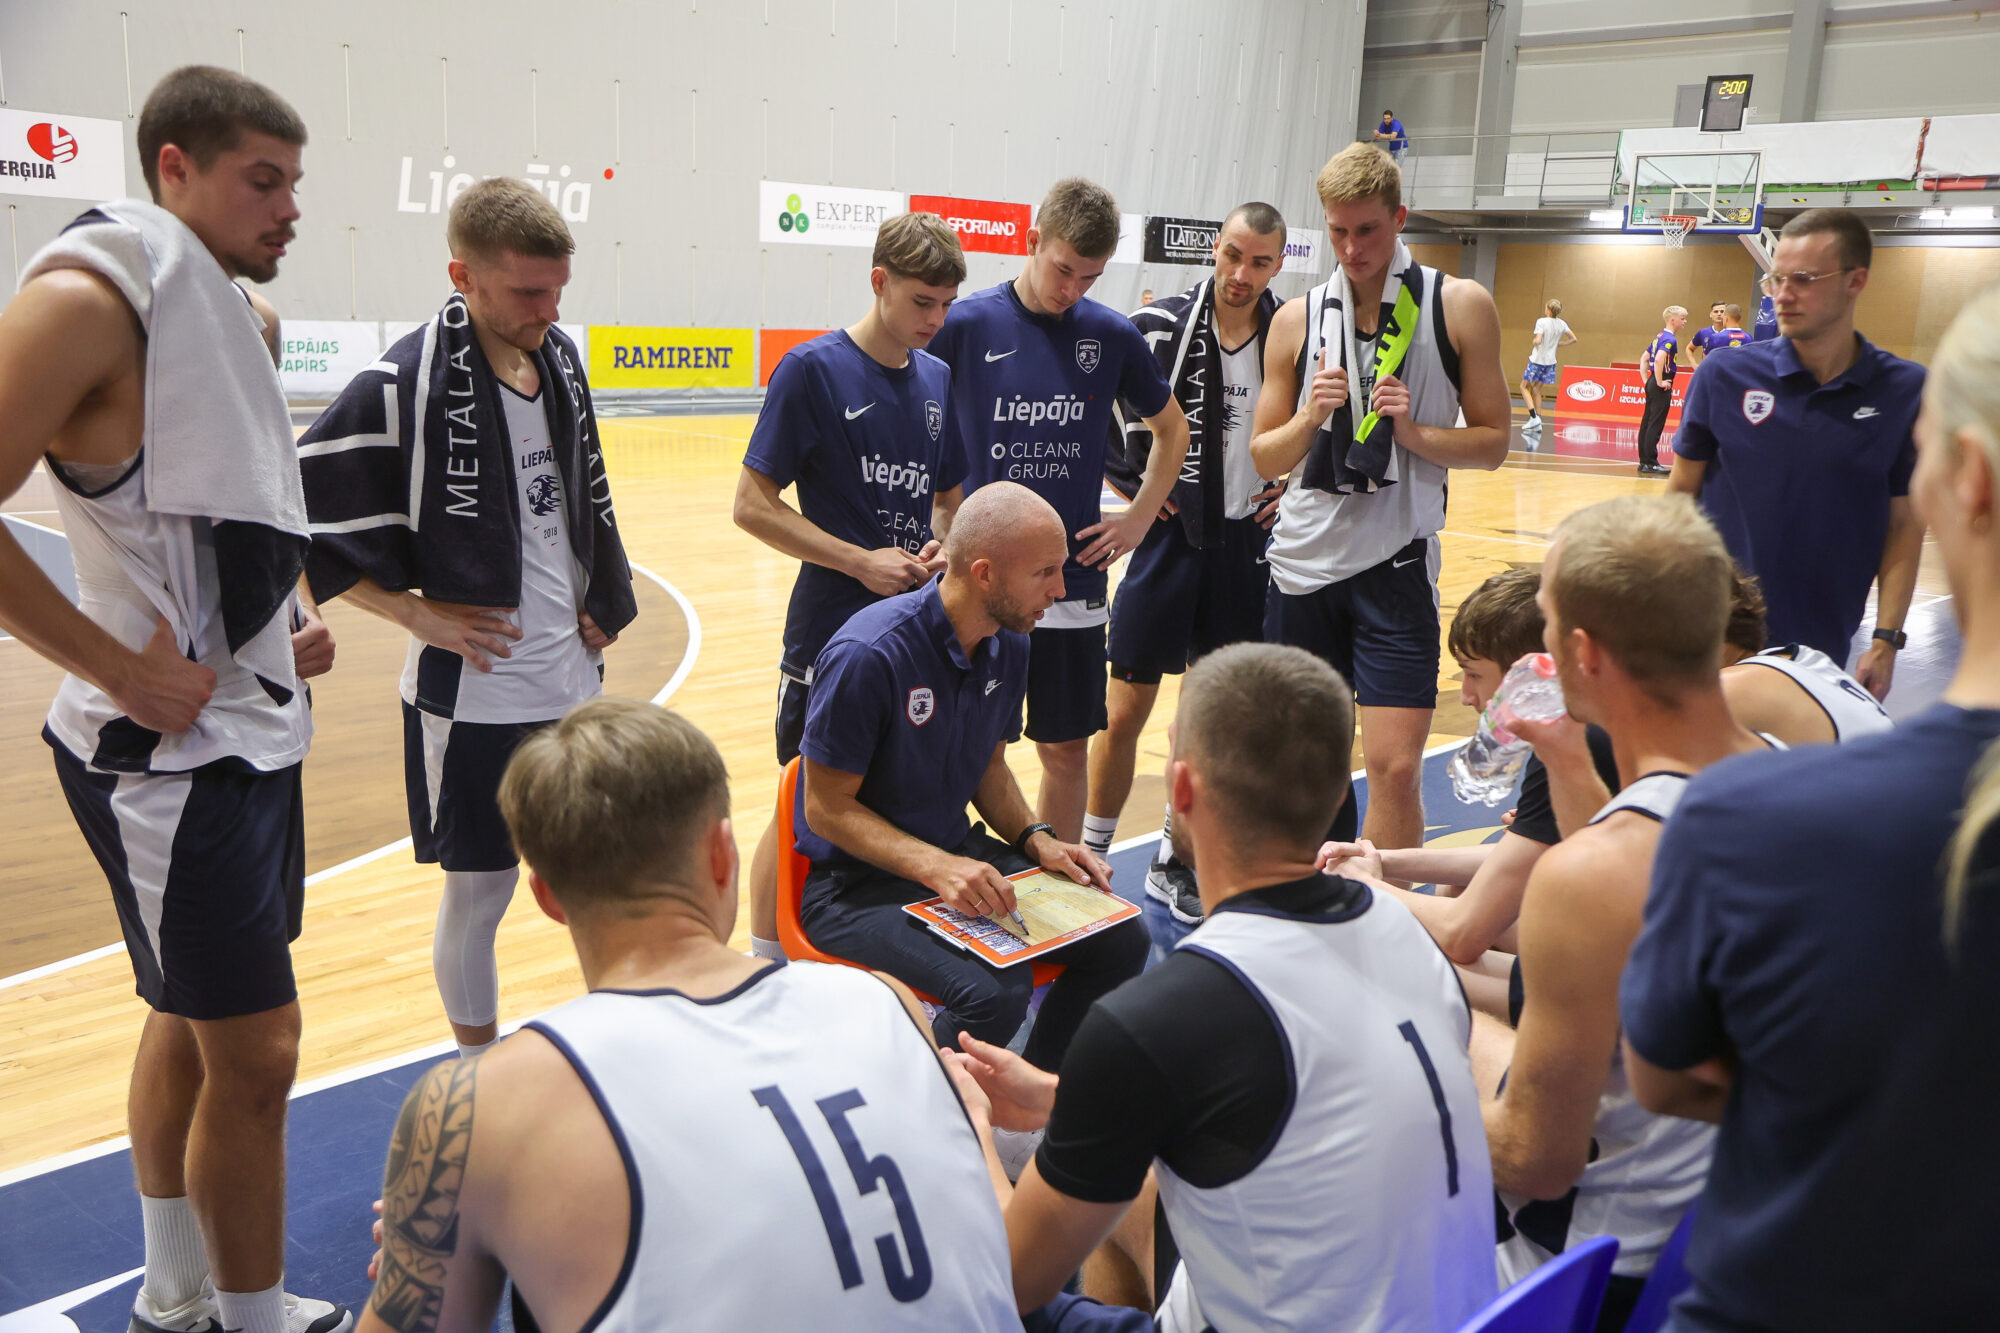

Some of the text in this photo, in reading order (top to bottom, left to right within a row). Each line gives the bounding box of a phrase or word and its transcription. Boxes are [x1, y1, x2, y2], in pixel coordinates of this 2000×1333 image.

[1719, 80, 1747, 95] 2:00
[0, 160, 56, 182] ERĢIJA
[816, 202, 887, 223] EXPERT
[947, 217, 1016, 236] SPORTLAND
[1286, 243, 1311, 258] ABALT
[281, 337, 339, 354] IEPĀJAS
[613, 346, 733, 369] RAMIRENT
[993, 394, 1085, 427] Liepāja
[445, 344, 478, 518] METĀLA
[522, 445, 557, 470] LIEPĀ
[1010, 442, 1081, 459] CLEANR
[1008, 463, 1070, 480] GRUPA
[544, 526, 558, 540] 2018
[1397, 1020, 1460, 1199] 1
[750, 1084, 934, 1304] 15
